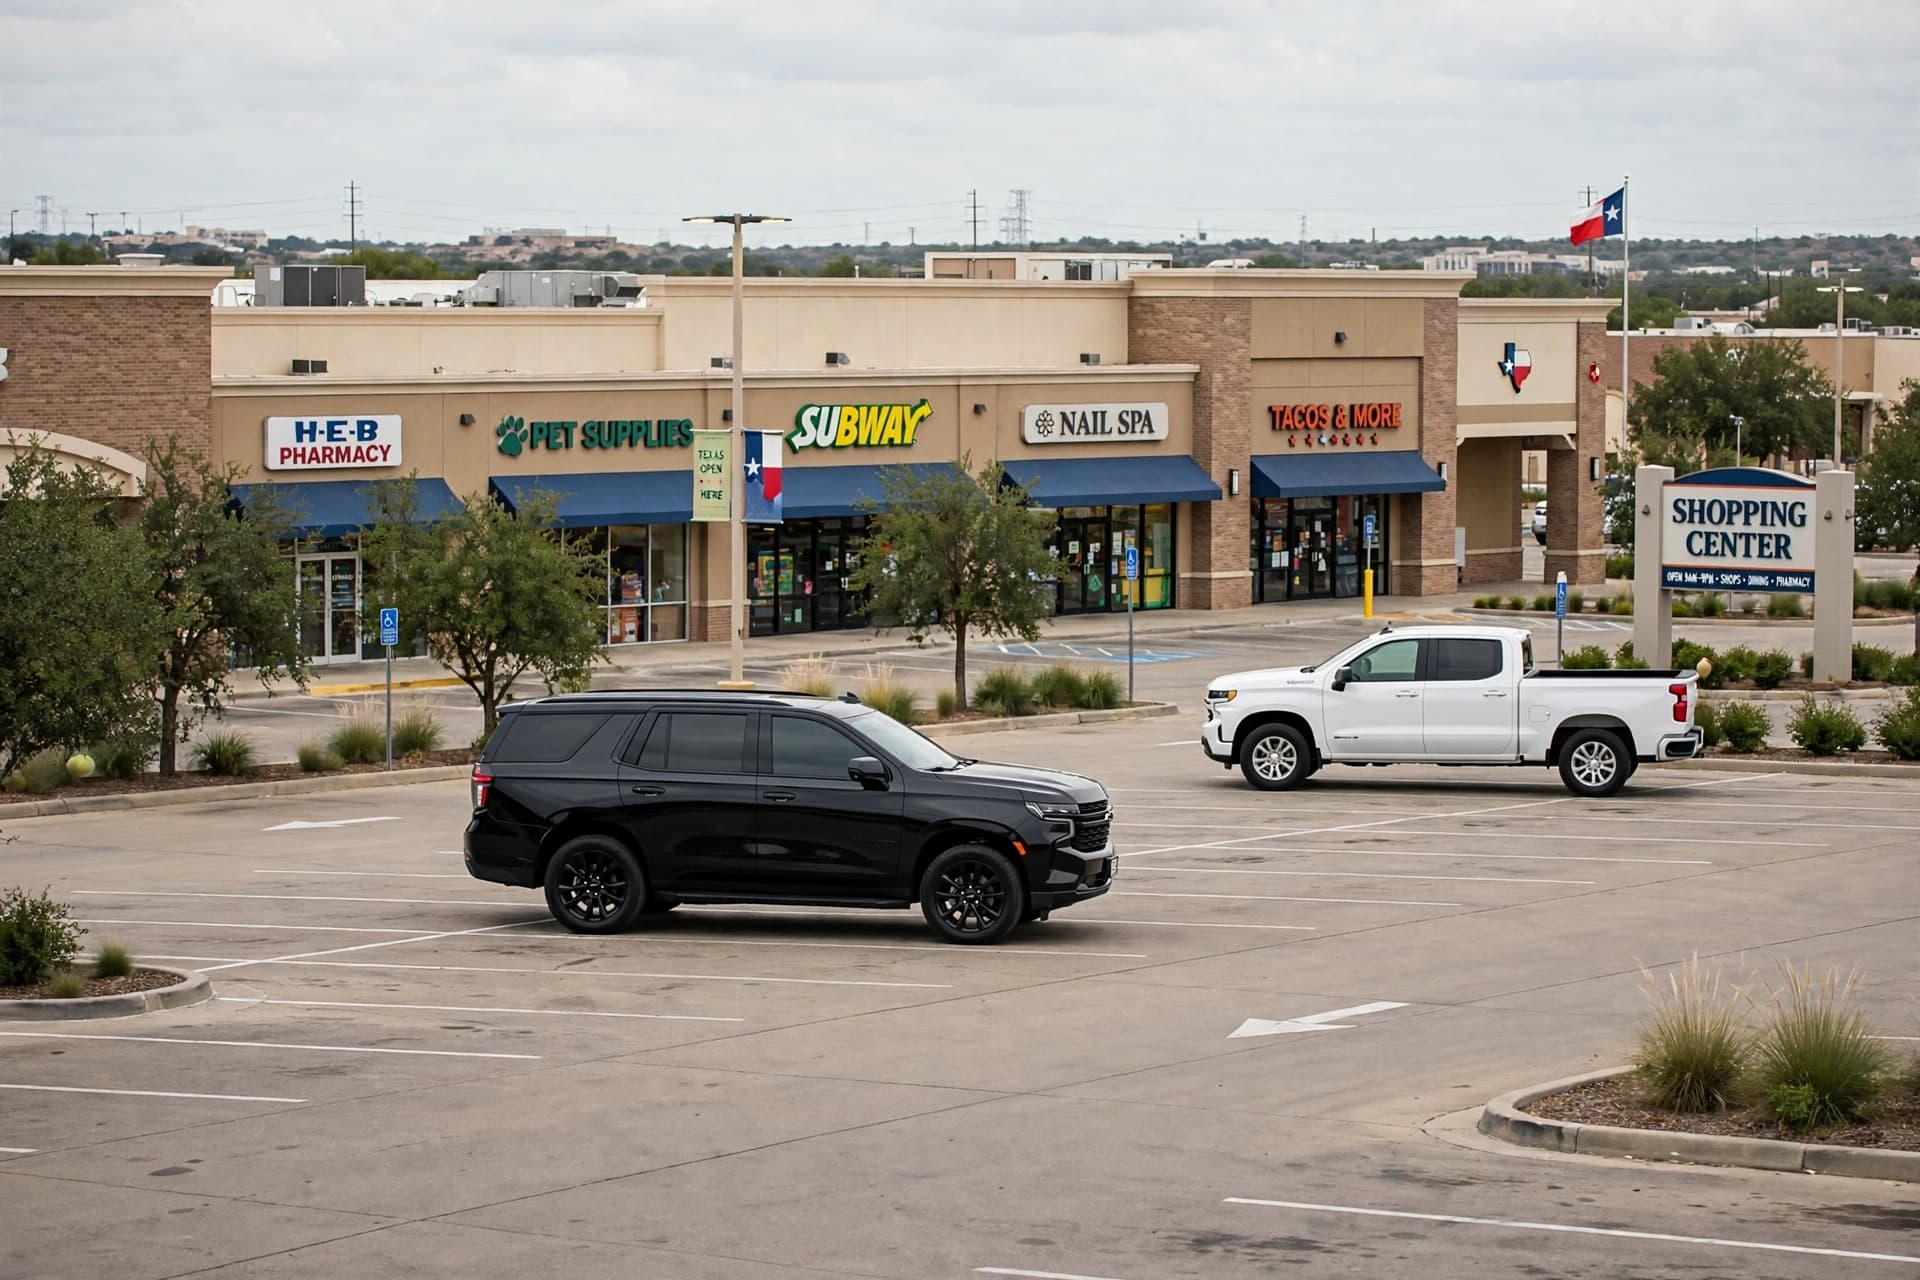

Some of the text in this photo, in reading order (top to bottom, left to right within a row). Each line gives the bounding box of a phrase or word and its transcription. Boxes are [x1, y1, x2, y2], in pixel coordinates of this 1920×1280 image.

[787, 399, 933, 453] SUBWAY
[1060, 409, 1156, 436] NAIL SPA
[1268, 403, 1402, 430] TACOS & MORE
[294, 420, 379, 443] H-E-B
[530, 419, 694, 449] PET SUPPLIES
[279, 444, 392, 465] PHARMACY
[700, 463, 722, 474] OPEN
[1672, 497, 1808, 528] SHOPPING
[1685, 530, 1793, 560] CENTER
[1720, 573, 1742, 585] SHOPS
[1776, 575, 1811, 588] PHARMACY
